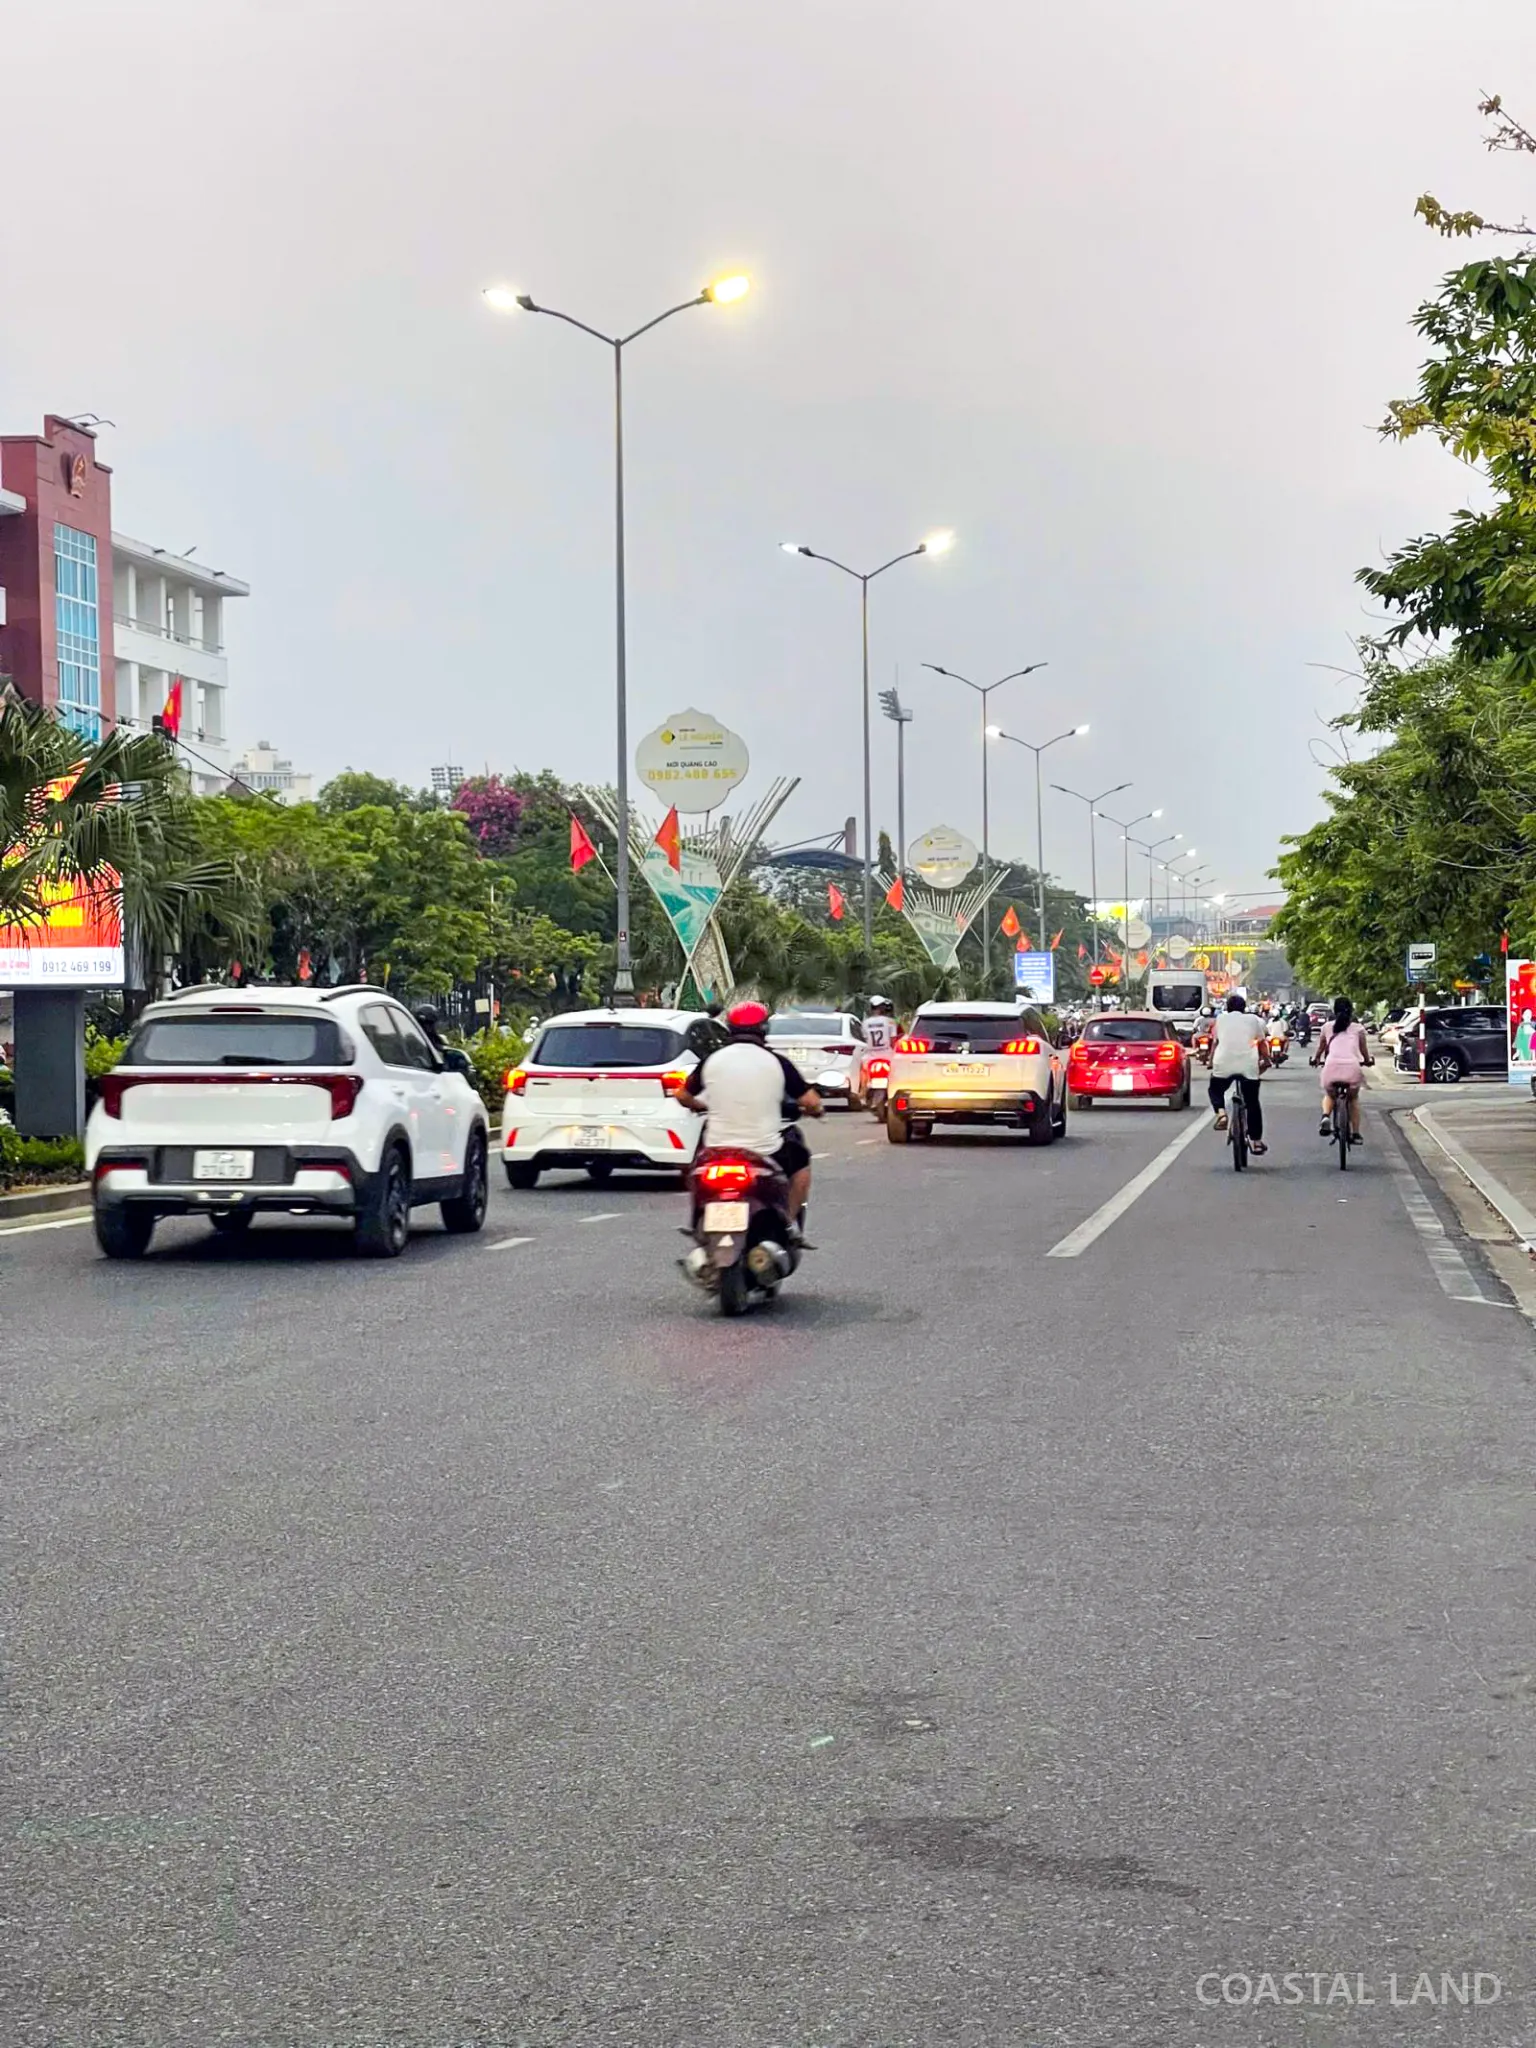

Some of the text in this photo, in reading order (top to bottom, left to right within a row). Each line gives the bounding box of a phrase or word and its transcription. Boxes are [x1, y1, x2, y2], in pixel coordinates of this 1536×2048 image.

[42, 961, 67, 972] 0912
[70, 961, 89, 972] 469
[93, 960, 112, 972] 199
[870, 1030, 885, 1047] 12
